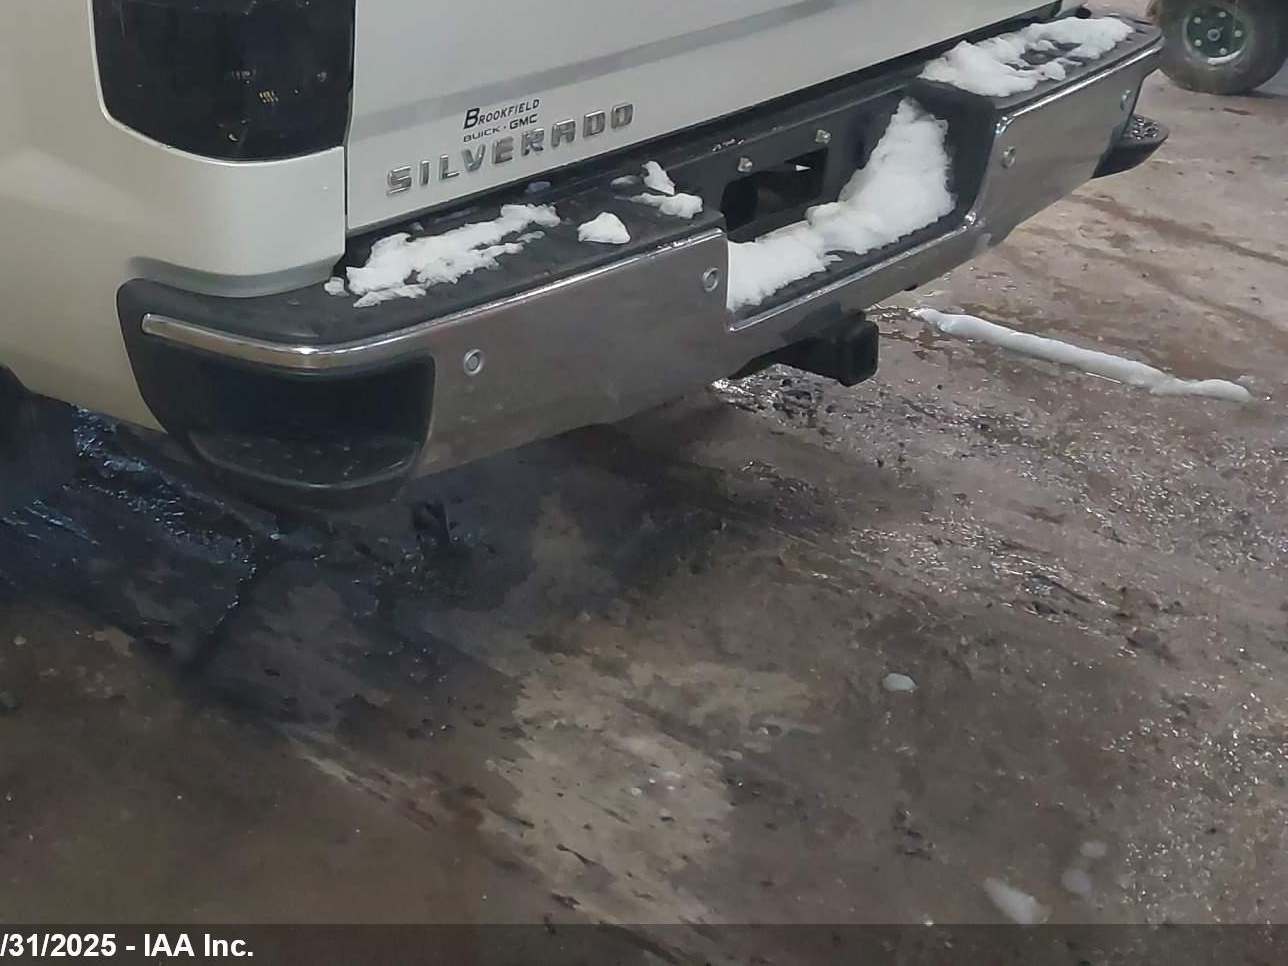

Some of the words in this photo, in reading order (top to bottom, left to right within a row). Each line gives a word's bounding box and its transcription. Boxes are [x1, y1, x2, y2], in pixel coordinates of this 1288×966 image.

[385, 103, 634, 197] SILVERADO
[463, 125, 501, 143] BUICK
[509, 113, 538, 130] GMC
